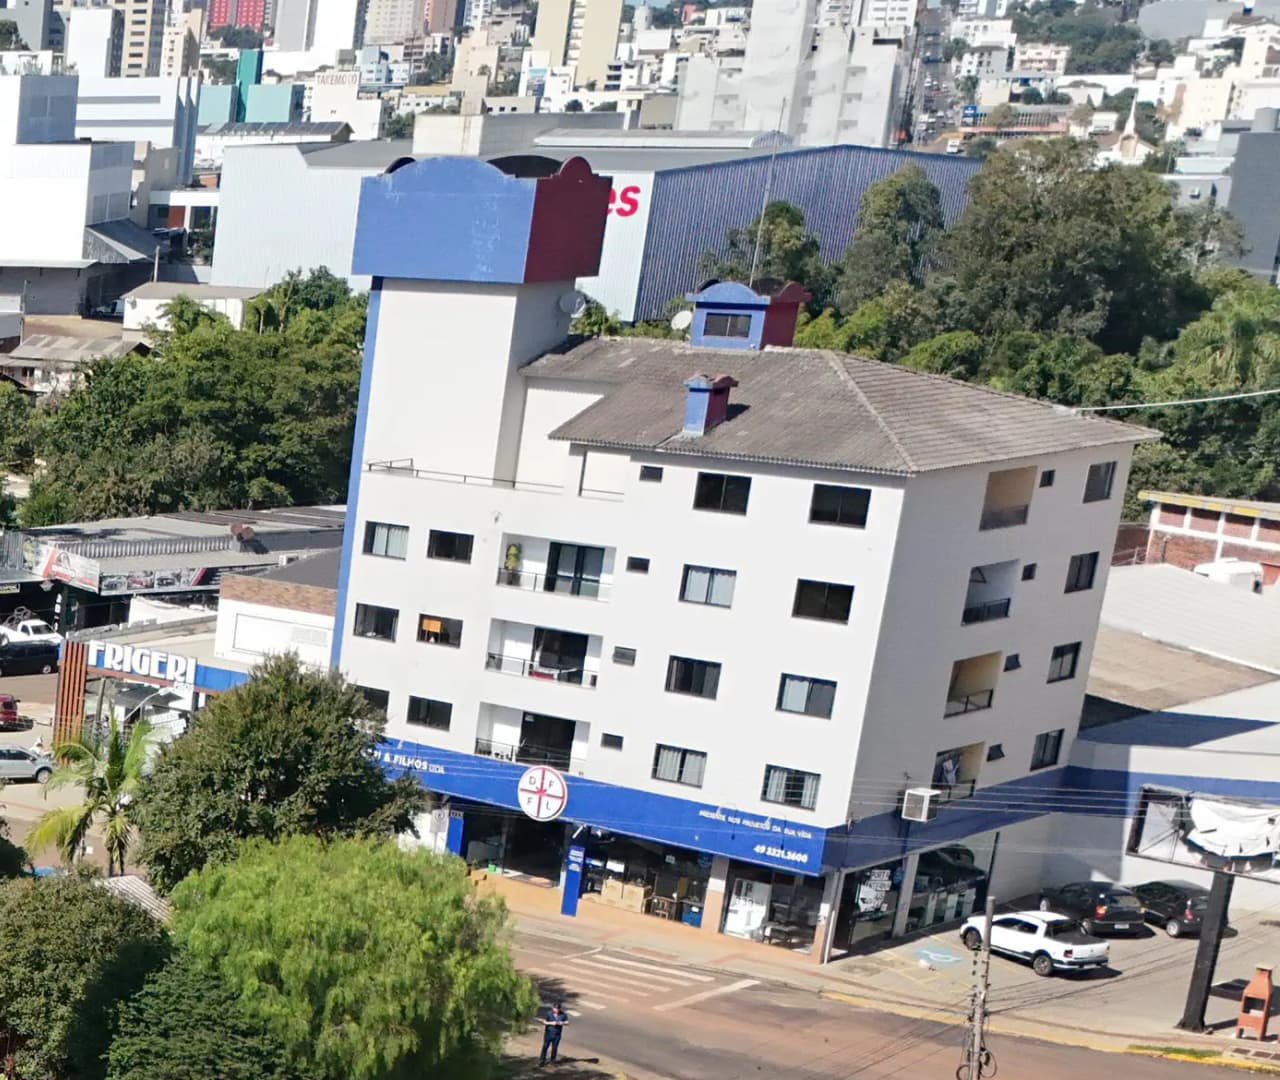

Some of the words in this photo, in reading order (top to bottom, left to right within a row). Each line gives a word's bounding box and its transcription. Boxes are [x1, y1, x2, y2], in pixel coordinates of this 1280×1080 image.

[88, 640, 197, 684] FRIGERI
[393, 754, 428, 770] FILHOS
[528, 775, 537, 786] D
[548, 780, 555, 789] F
[527, 796, 534, 804] F
[545, 800, 551, 811] L
